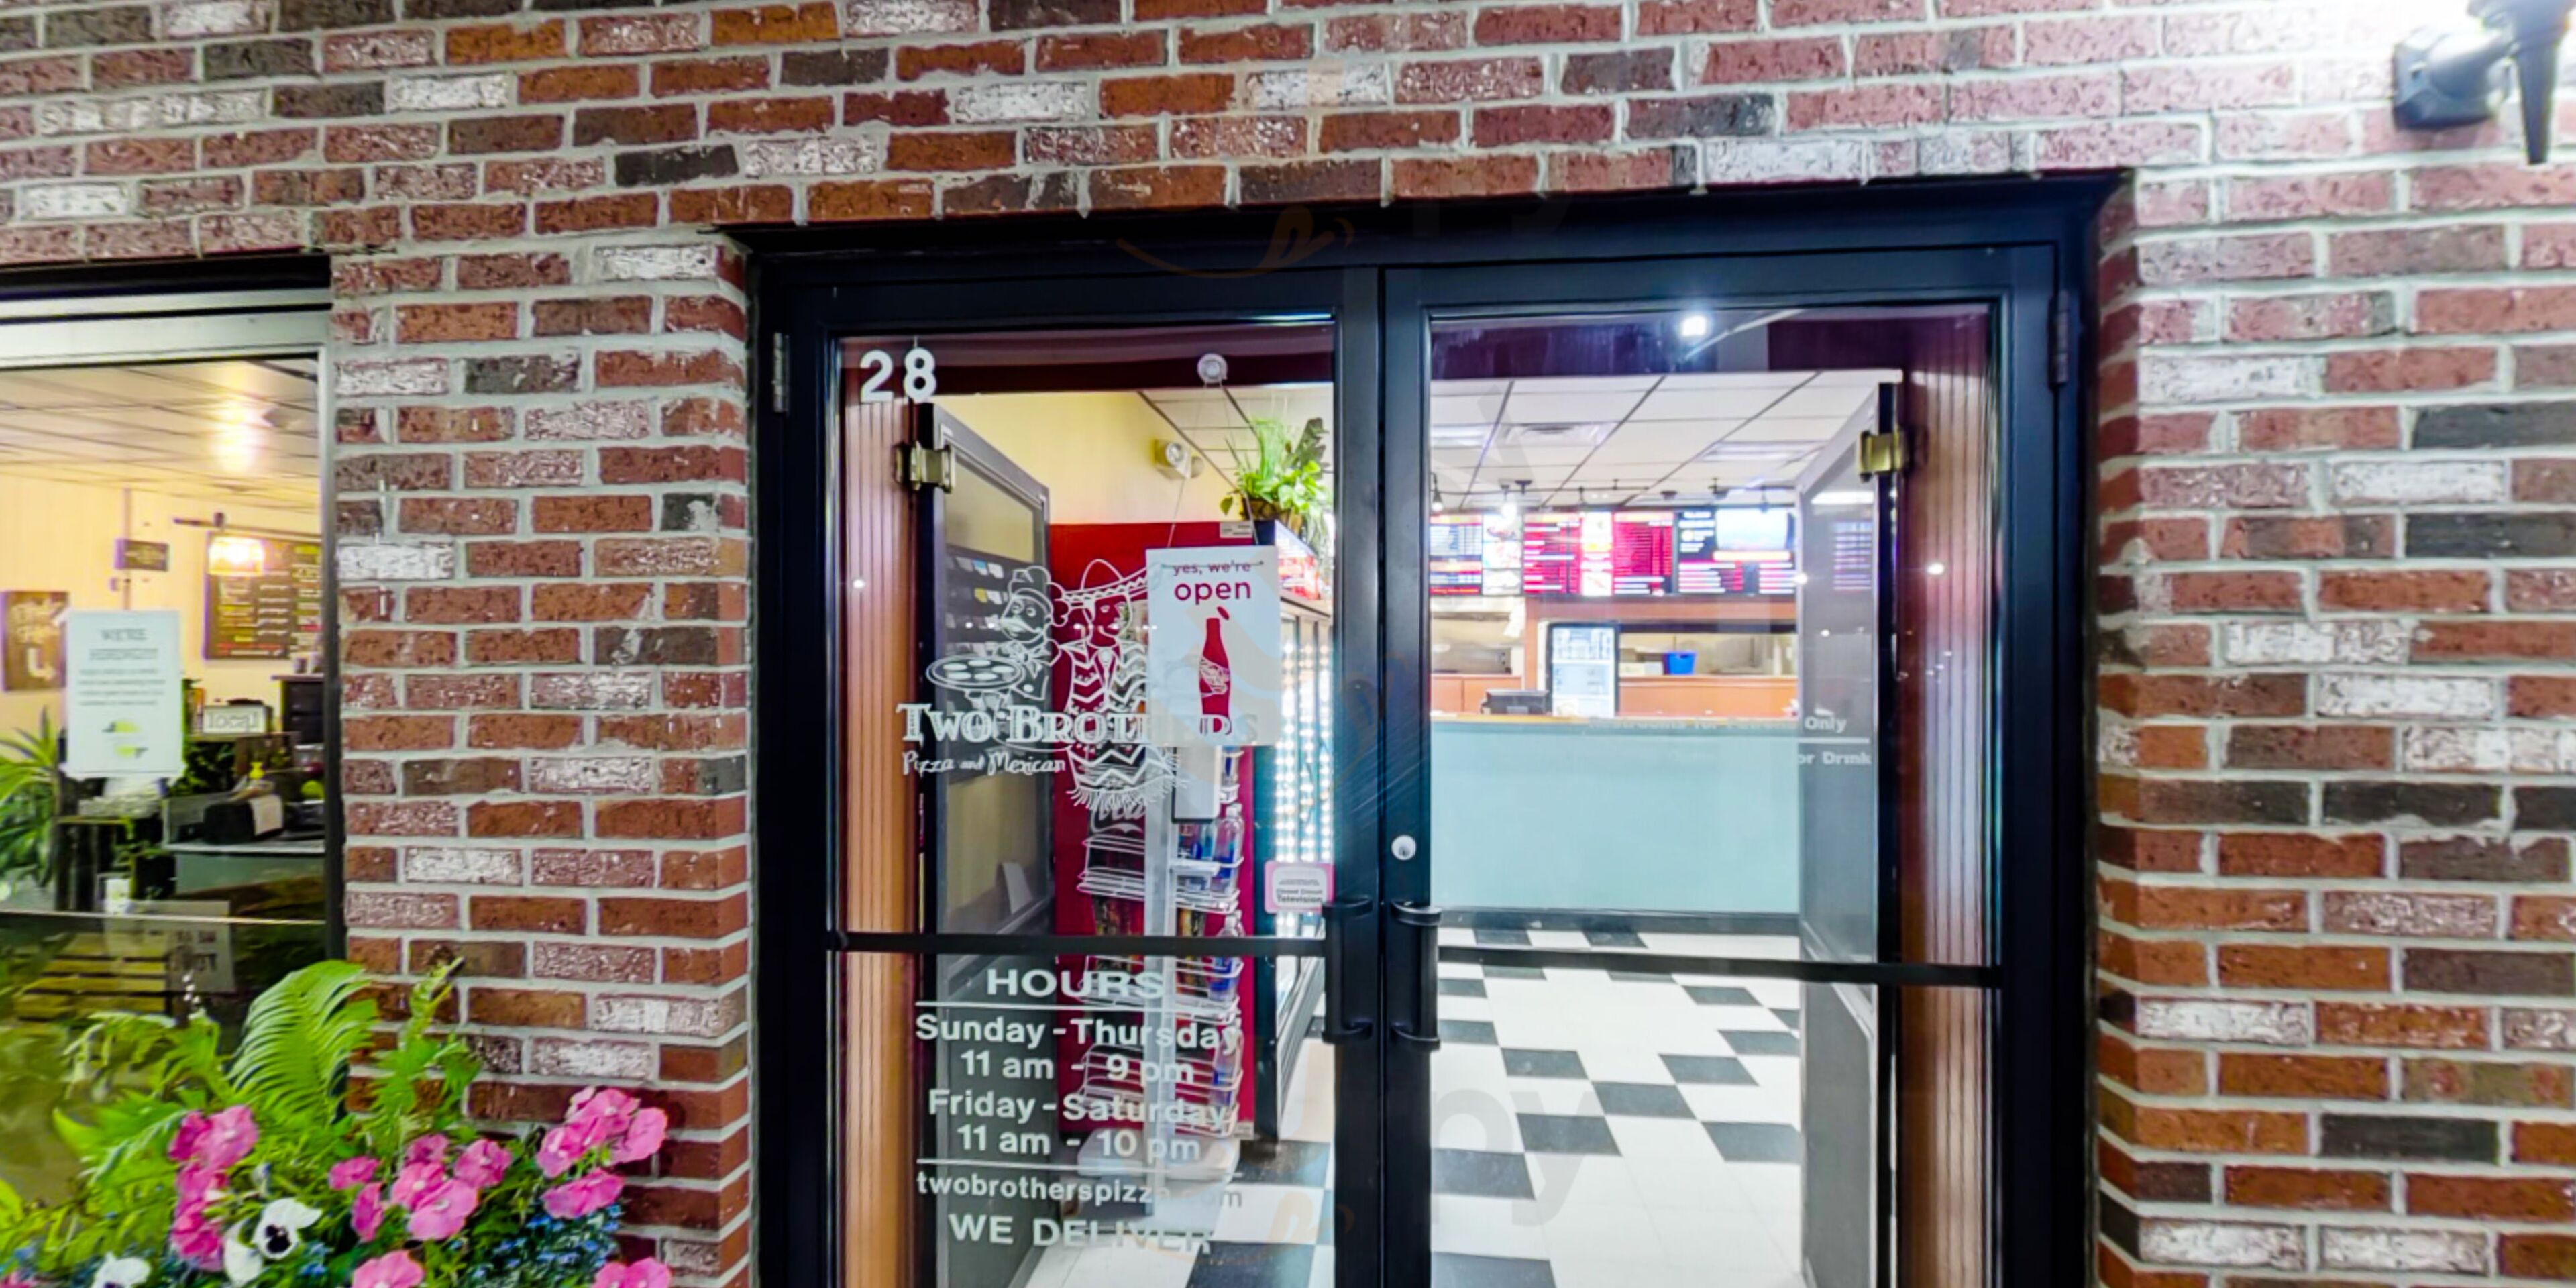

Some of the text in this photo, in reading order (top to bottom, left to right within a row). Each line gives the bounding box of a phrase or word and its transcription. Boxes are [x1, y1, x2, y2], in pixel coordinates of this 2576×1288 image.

[860, 347, 936, 404] 28
[1173, 559, 1251, 576] yes, we're
[1174, 582, 1251, 605] open
[1005, 704, 1258, 744] BROTRS
[1805, 716, 1847, 733] Only
[902, 750, 1066, 778] Pizza and Mexican
[1823, 751, 1872, 765] Drink
[987, 969, 1165, 999] HOURS
[916, 1014, 1045, 1049] Sunday
[1070, 1018, 1239, 1055] Thursday
[961, 1049, 989, 1077] 11
[1002, 1057, 1054, 1079] am
[1107, 1054, 1129, 1081] 9
[1141, 1061, 1195, 1088] pm
[929, 1089, 1036, 1124] Friday
[1063, 1093, 1227, 1128] Saturday
[957, 1124, 987, 1151] 11
[999, 1132, 1051, 1155] am
[1097, 1129, 1137, 1157] 10
[1146, 1138, 1200, 1165] pm
[916, 1171, 1242, 1207] twobrotherspizzm
[948, 1214, 1014, 1244] WE
